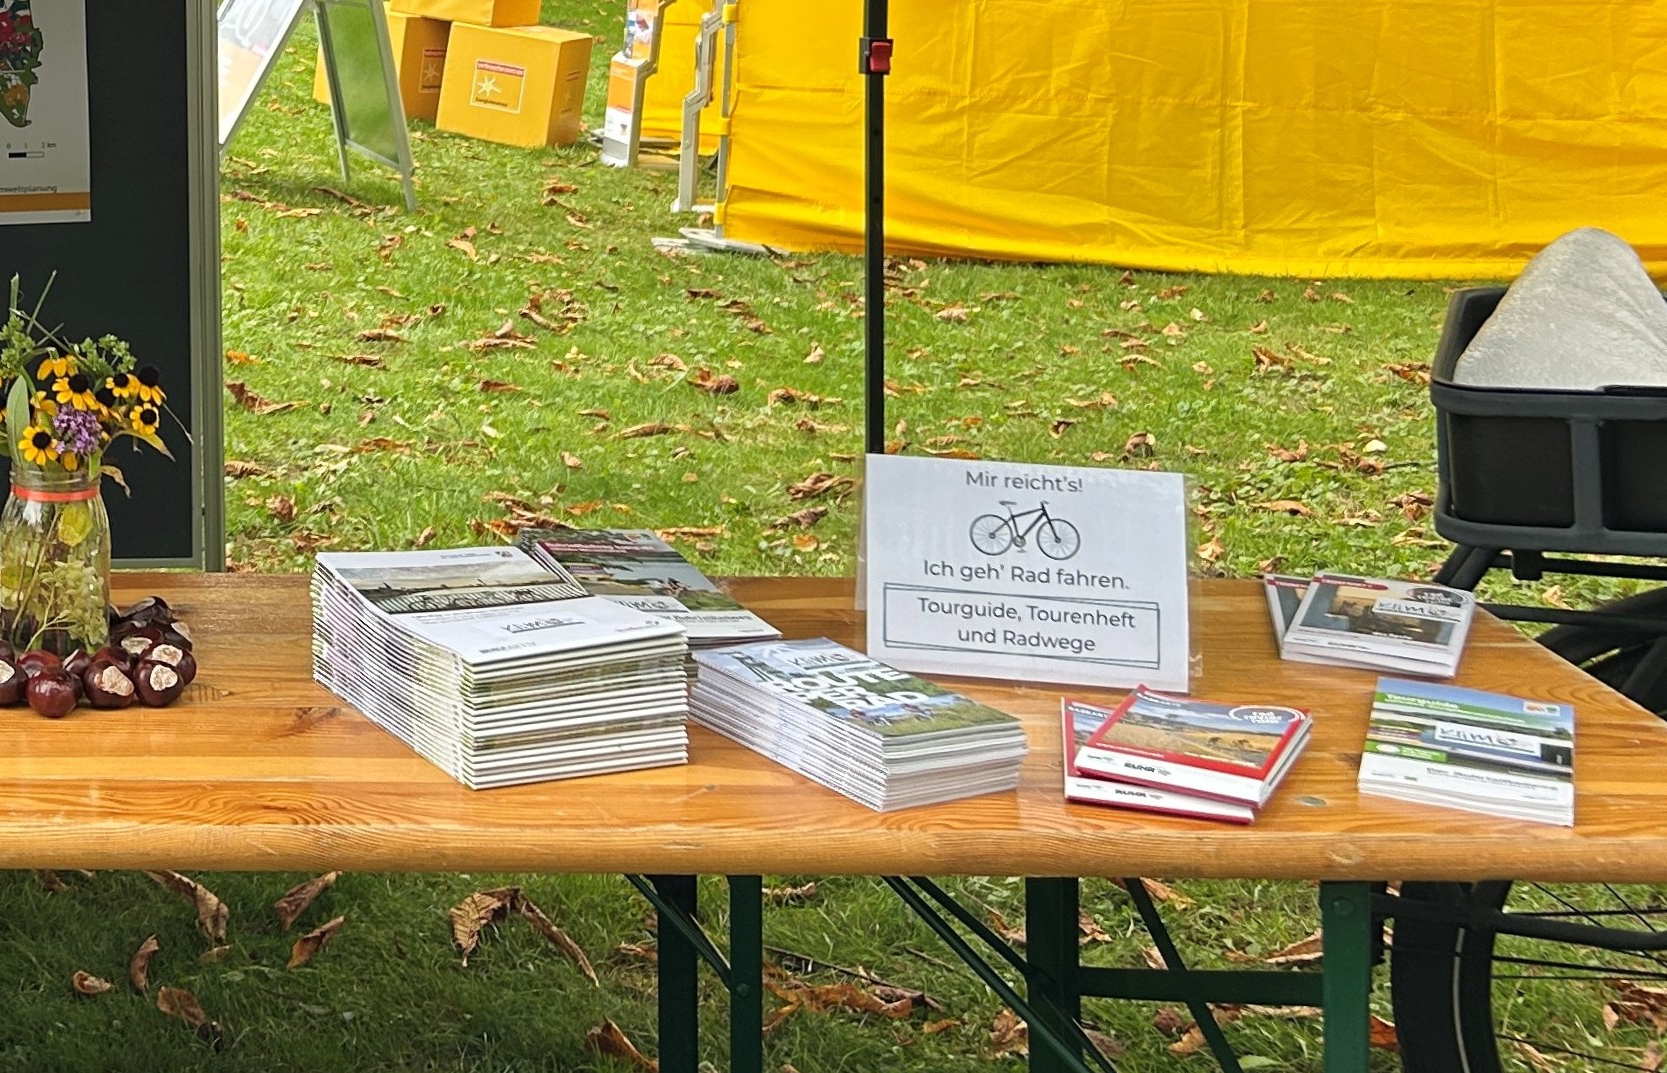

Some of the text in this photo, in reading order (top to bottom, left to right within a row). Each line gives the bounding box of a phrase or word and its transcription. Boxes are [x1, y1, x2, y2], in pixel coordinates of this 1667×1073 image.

[965, 470, 1084, 493] Mir reicht's!
[923, 559, 1130, 591] Ich geh' Rad fahren.
[917, 597, 1136, 629] Tourguide, Tourenheft
[957, 628, 1096, 654] und Radwege
[767, 667, 911, 694] ROUTE
